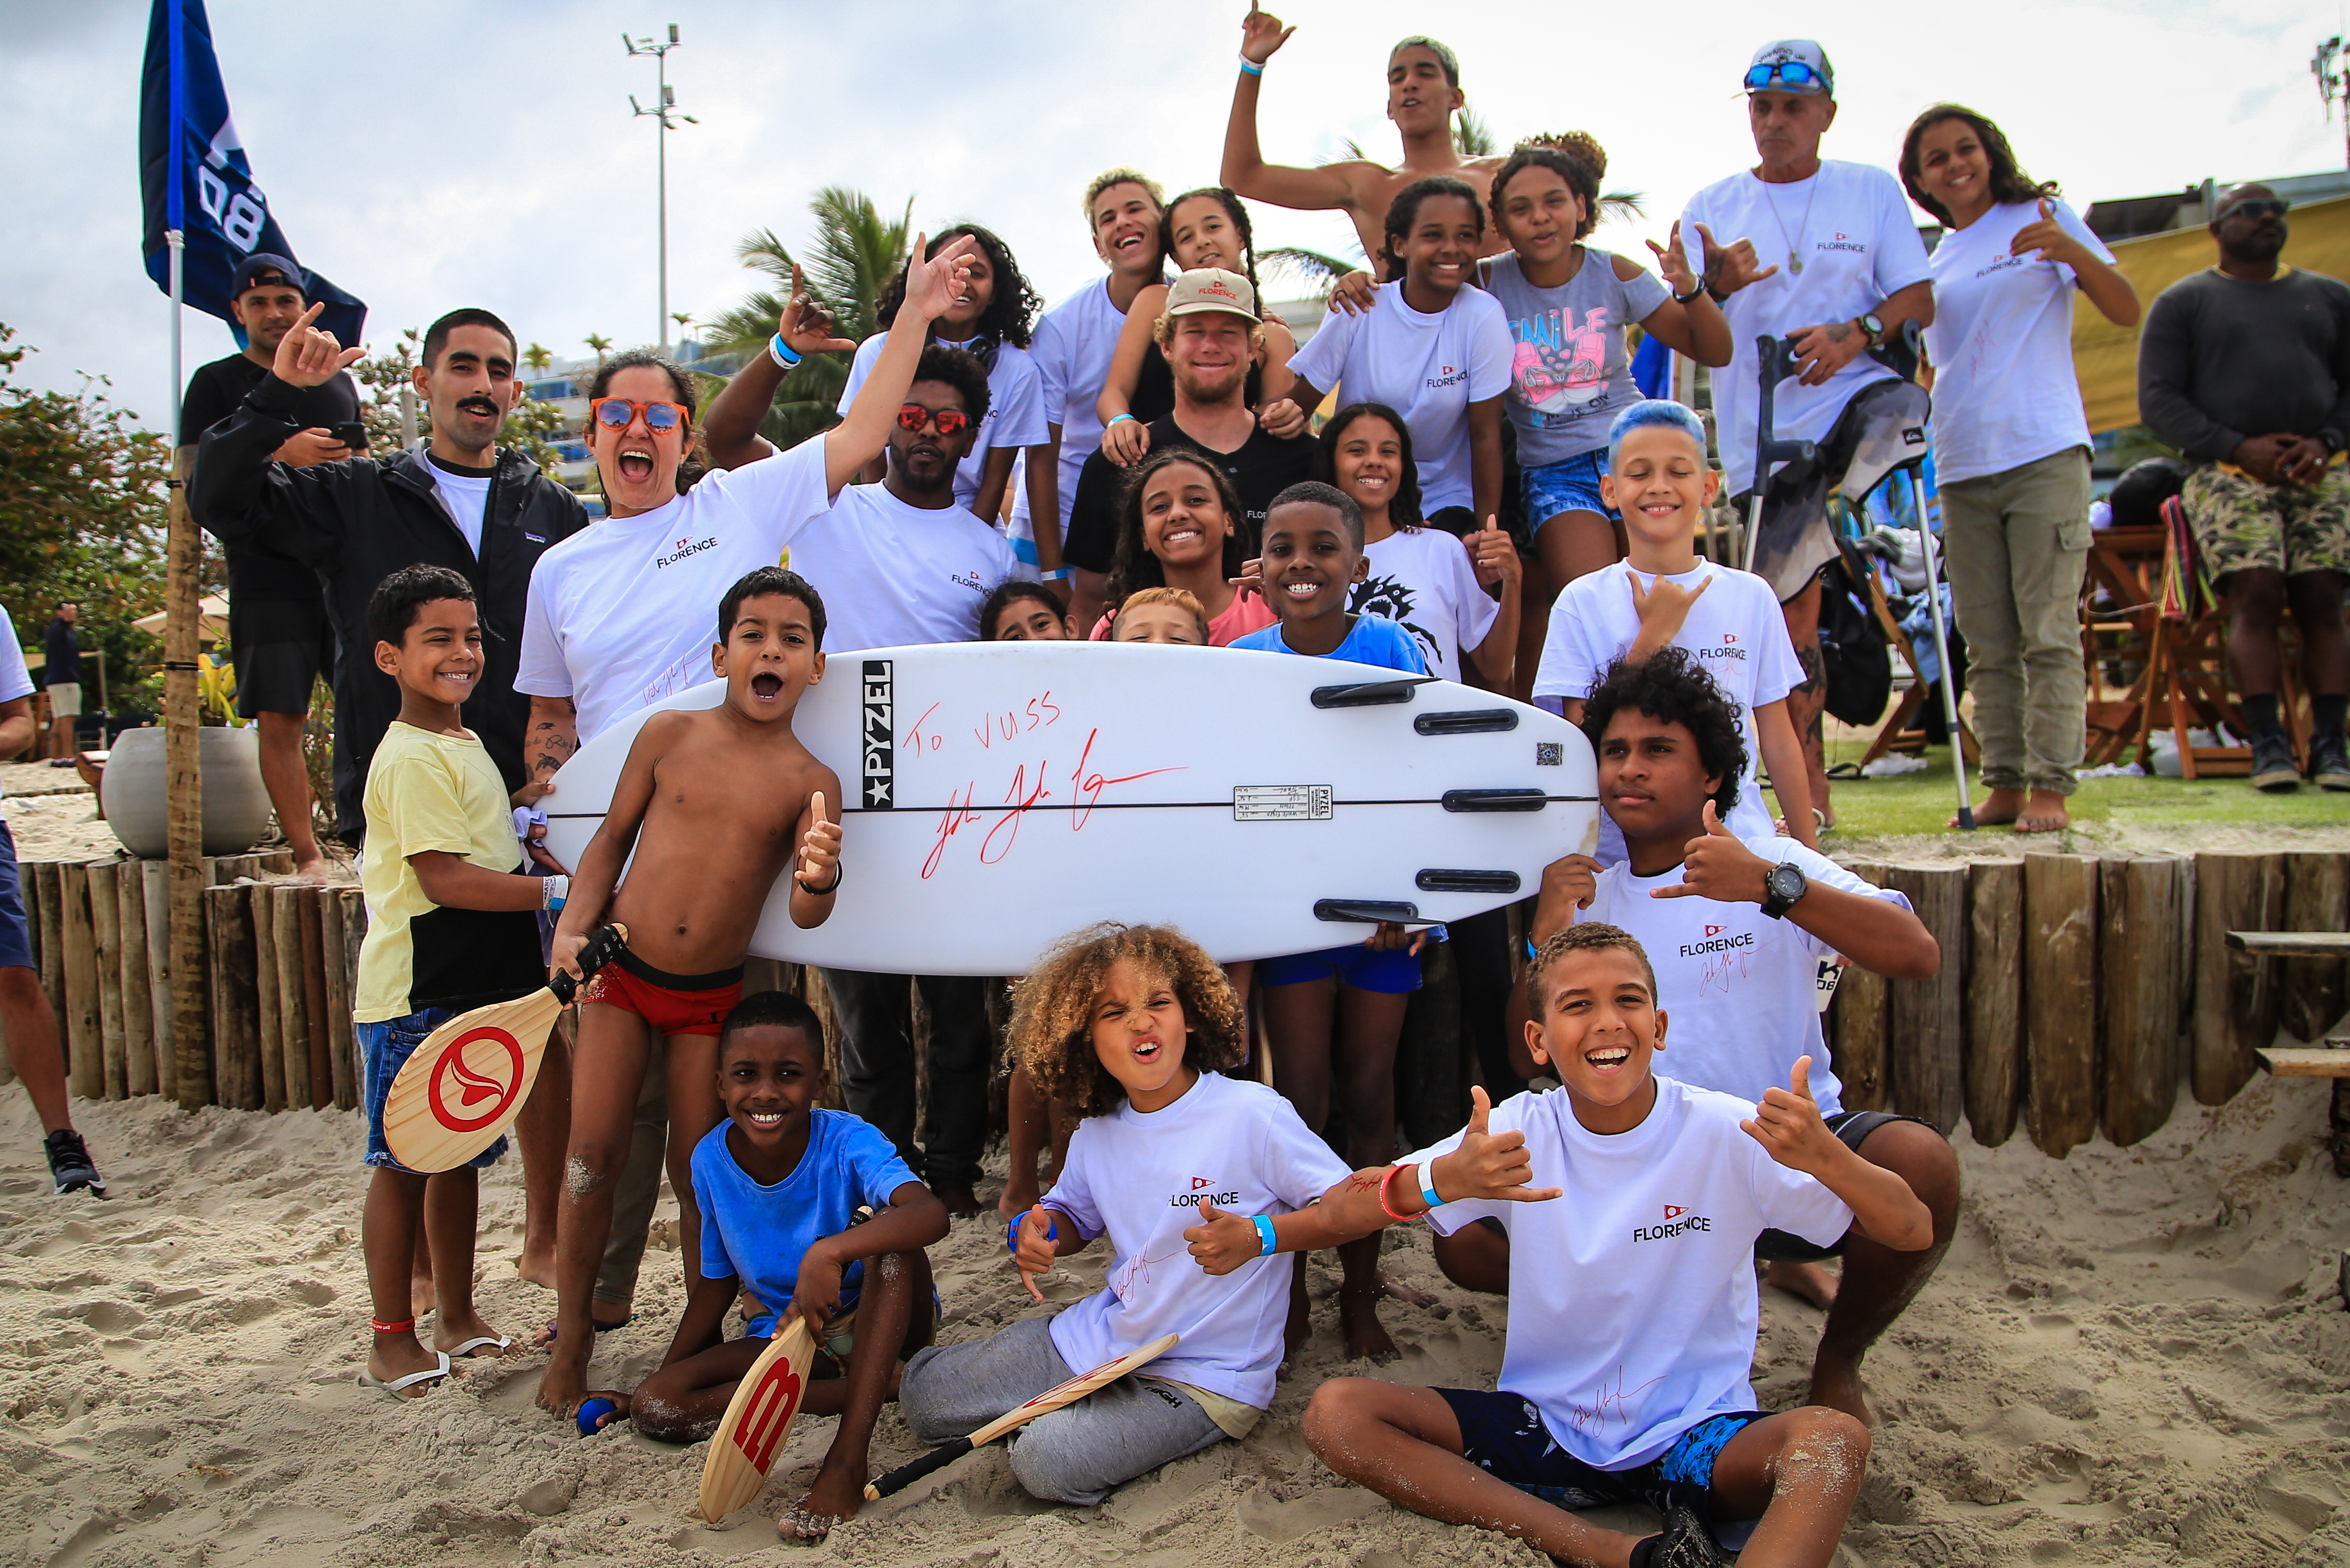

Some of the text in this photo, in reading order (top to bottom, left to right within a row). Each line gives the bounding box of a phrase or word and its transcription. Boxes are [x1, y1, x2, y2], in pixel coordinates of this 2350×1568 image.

[1818, 242, 1866, 252] FLORENCE
[1199, 288, 1237, 300] FLORENCE
[657, 537, 719, 569] FLORENCE
[1700, 647, 1747, 660] FLORENCE
[864, 661, 892, 778] PYZEL
[1320, 789, 1329, 816] PYZEL
[1680, 933, 1754, 957] FLORENCE
[1166, 1191, 1239, 1207] LORNCE
[1633, 1216, 1711, 1243] FLORENCE
